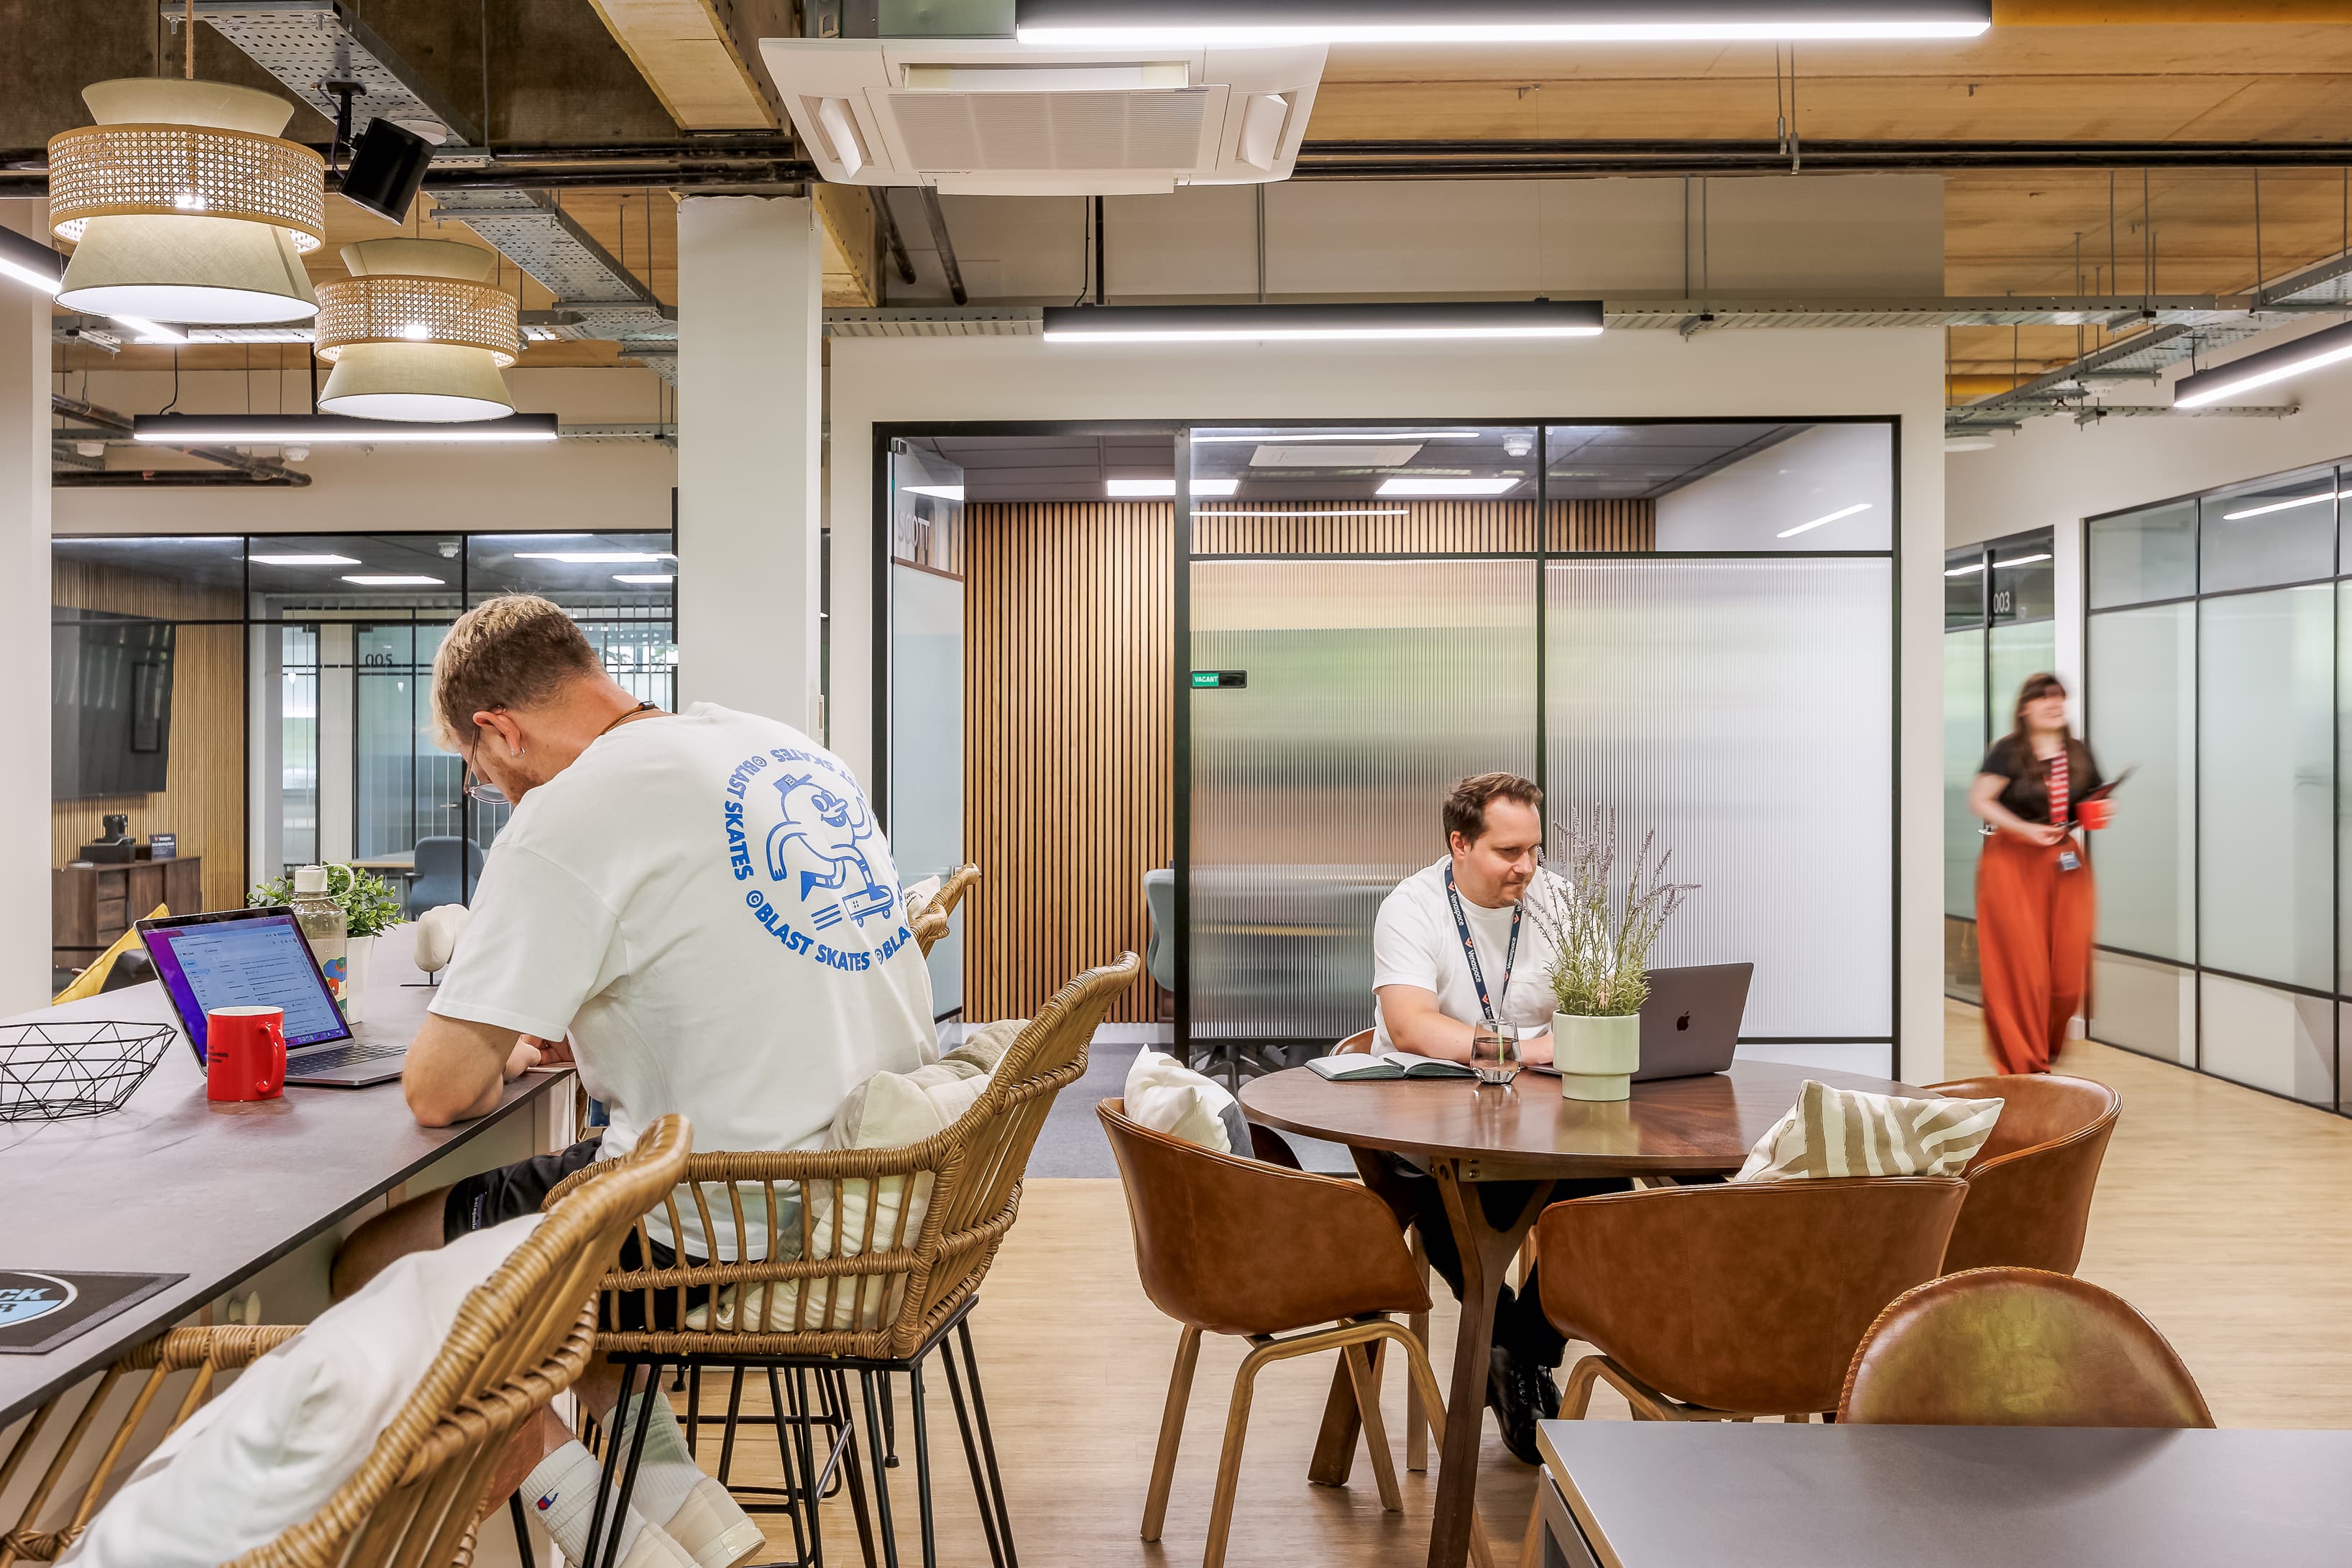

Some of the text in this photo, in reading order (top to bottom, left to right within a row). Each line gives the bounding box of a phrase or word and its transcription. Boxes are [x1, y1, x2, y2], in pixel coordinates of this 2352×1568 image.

[898, 509, 930, 550] SCOTT
[1993, 591, 2010, 612] 003
[365, 654, 392, 667] 005
[725, 801, 753, 880] SKATES
[1451, 893, 1464, 926] Venaspace
[814, 944, 870, 972] SKATES
[1468, 949, 1482, 982] Venaspace
